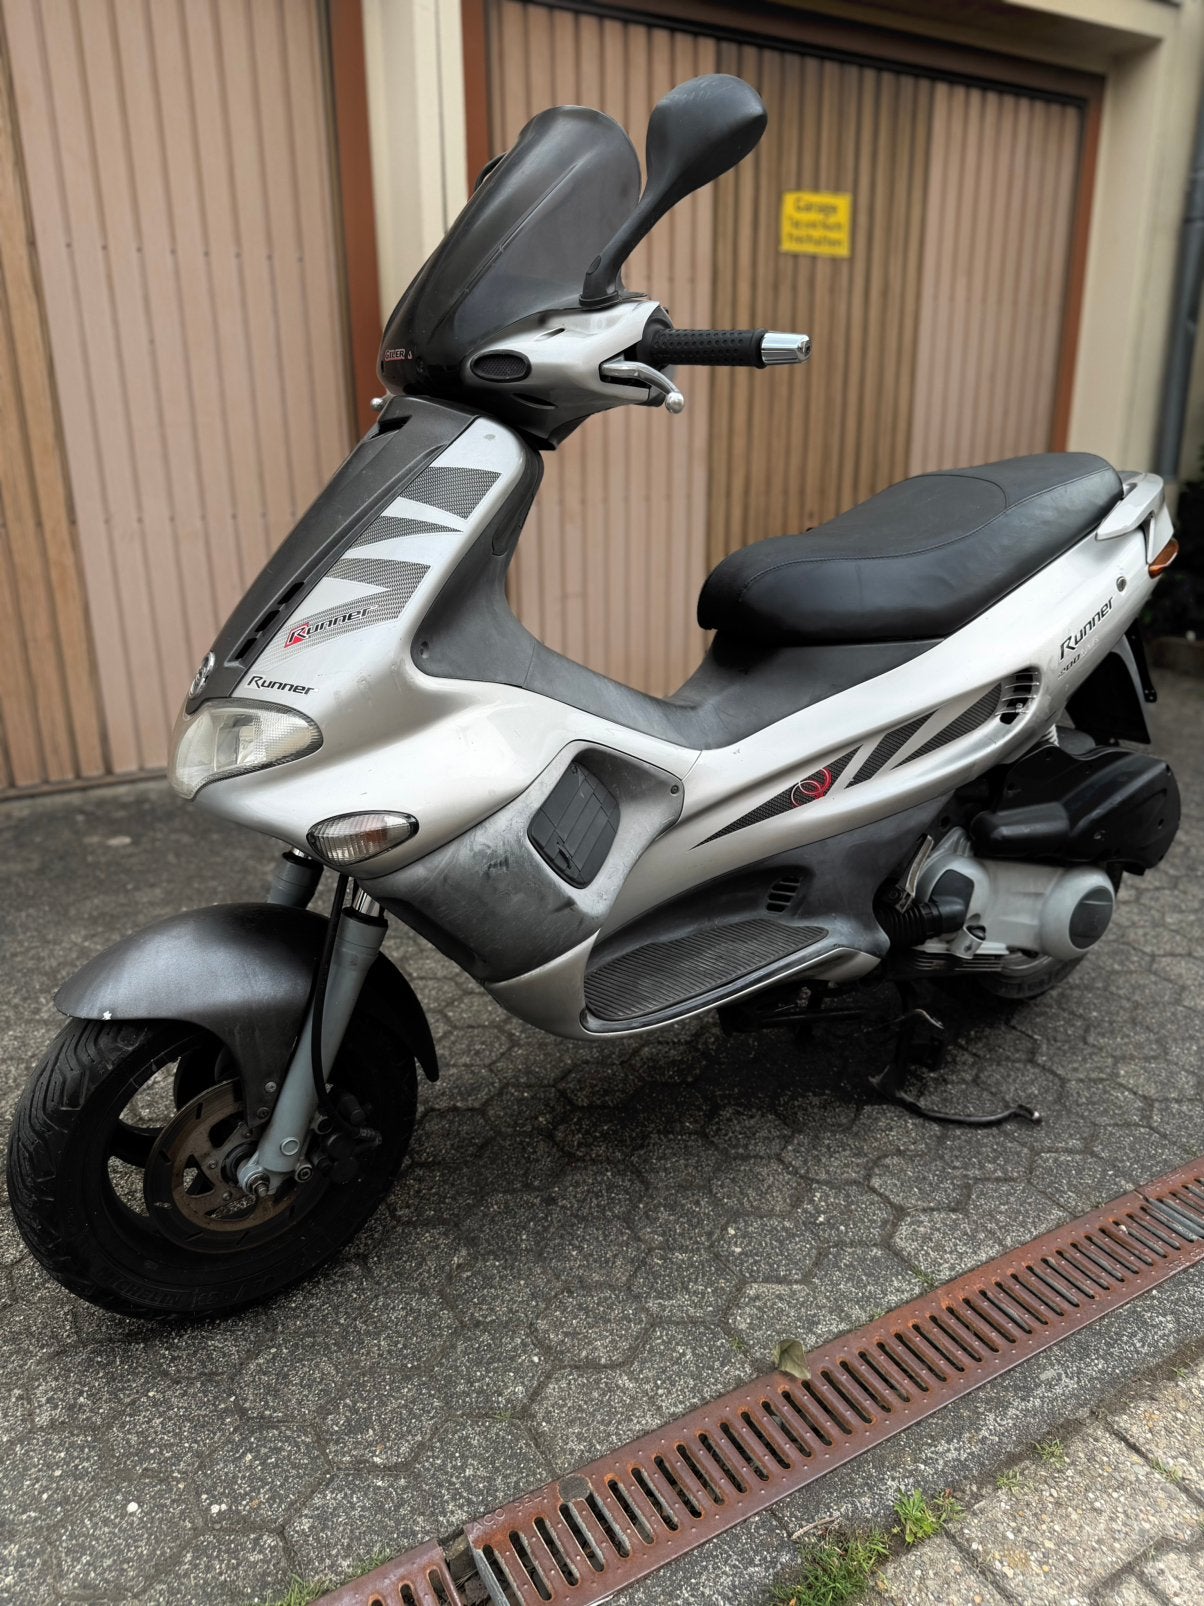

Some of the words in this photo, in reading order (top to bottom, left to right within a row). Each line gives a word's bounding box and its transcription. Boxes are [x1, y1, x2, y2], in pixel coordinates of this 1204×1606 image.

[288, 606, 372, 643] Runner
[1060, 596, 1113, 661] Runner
[247, 675, 315, 695] Runner
[472, 1508, 506, 1534] ACO
